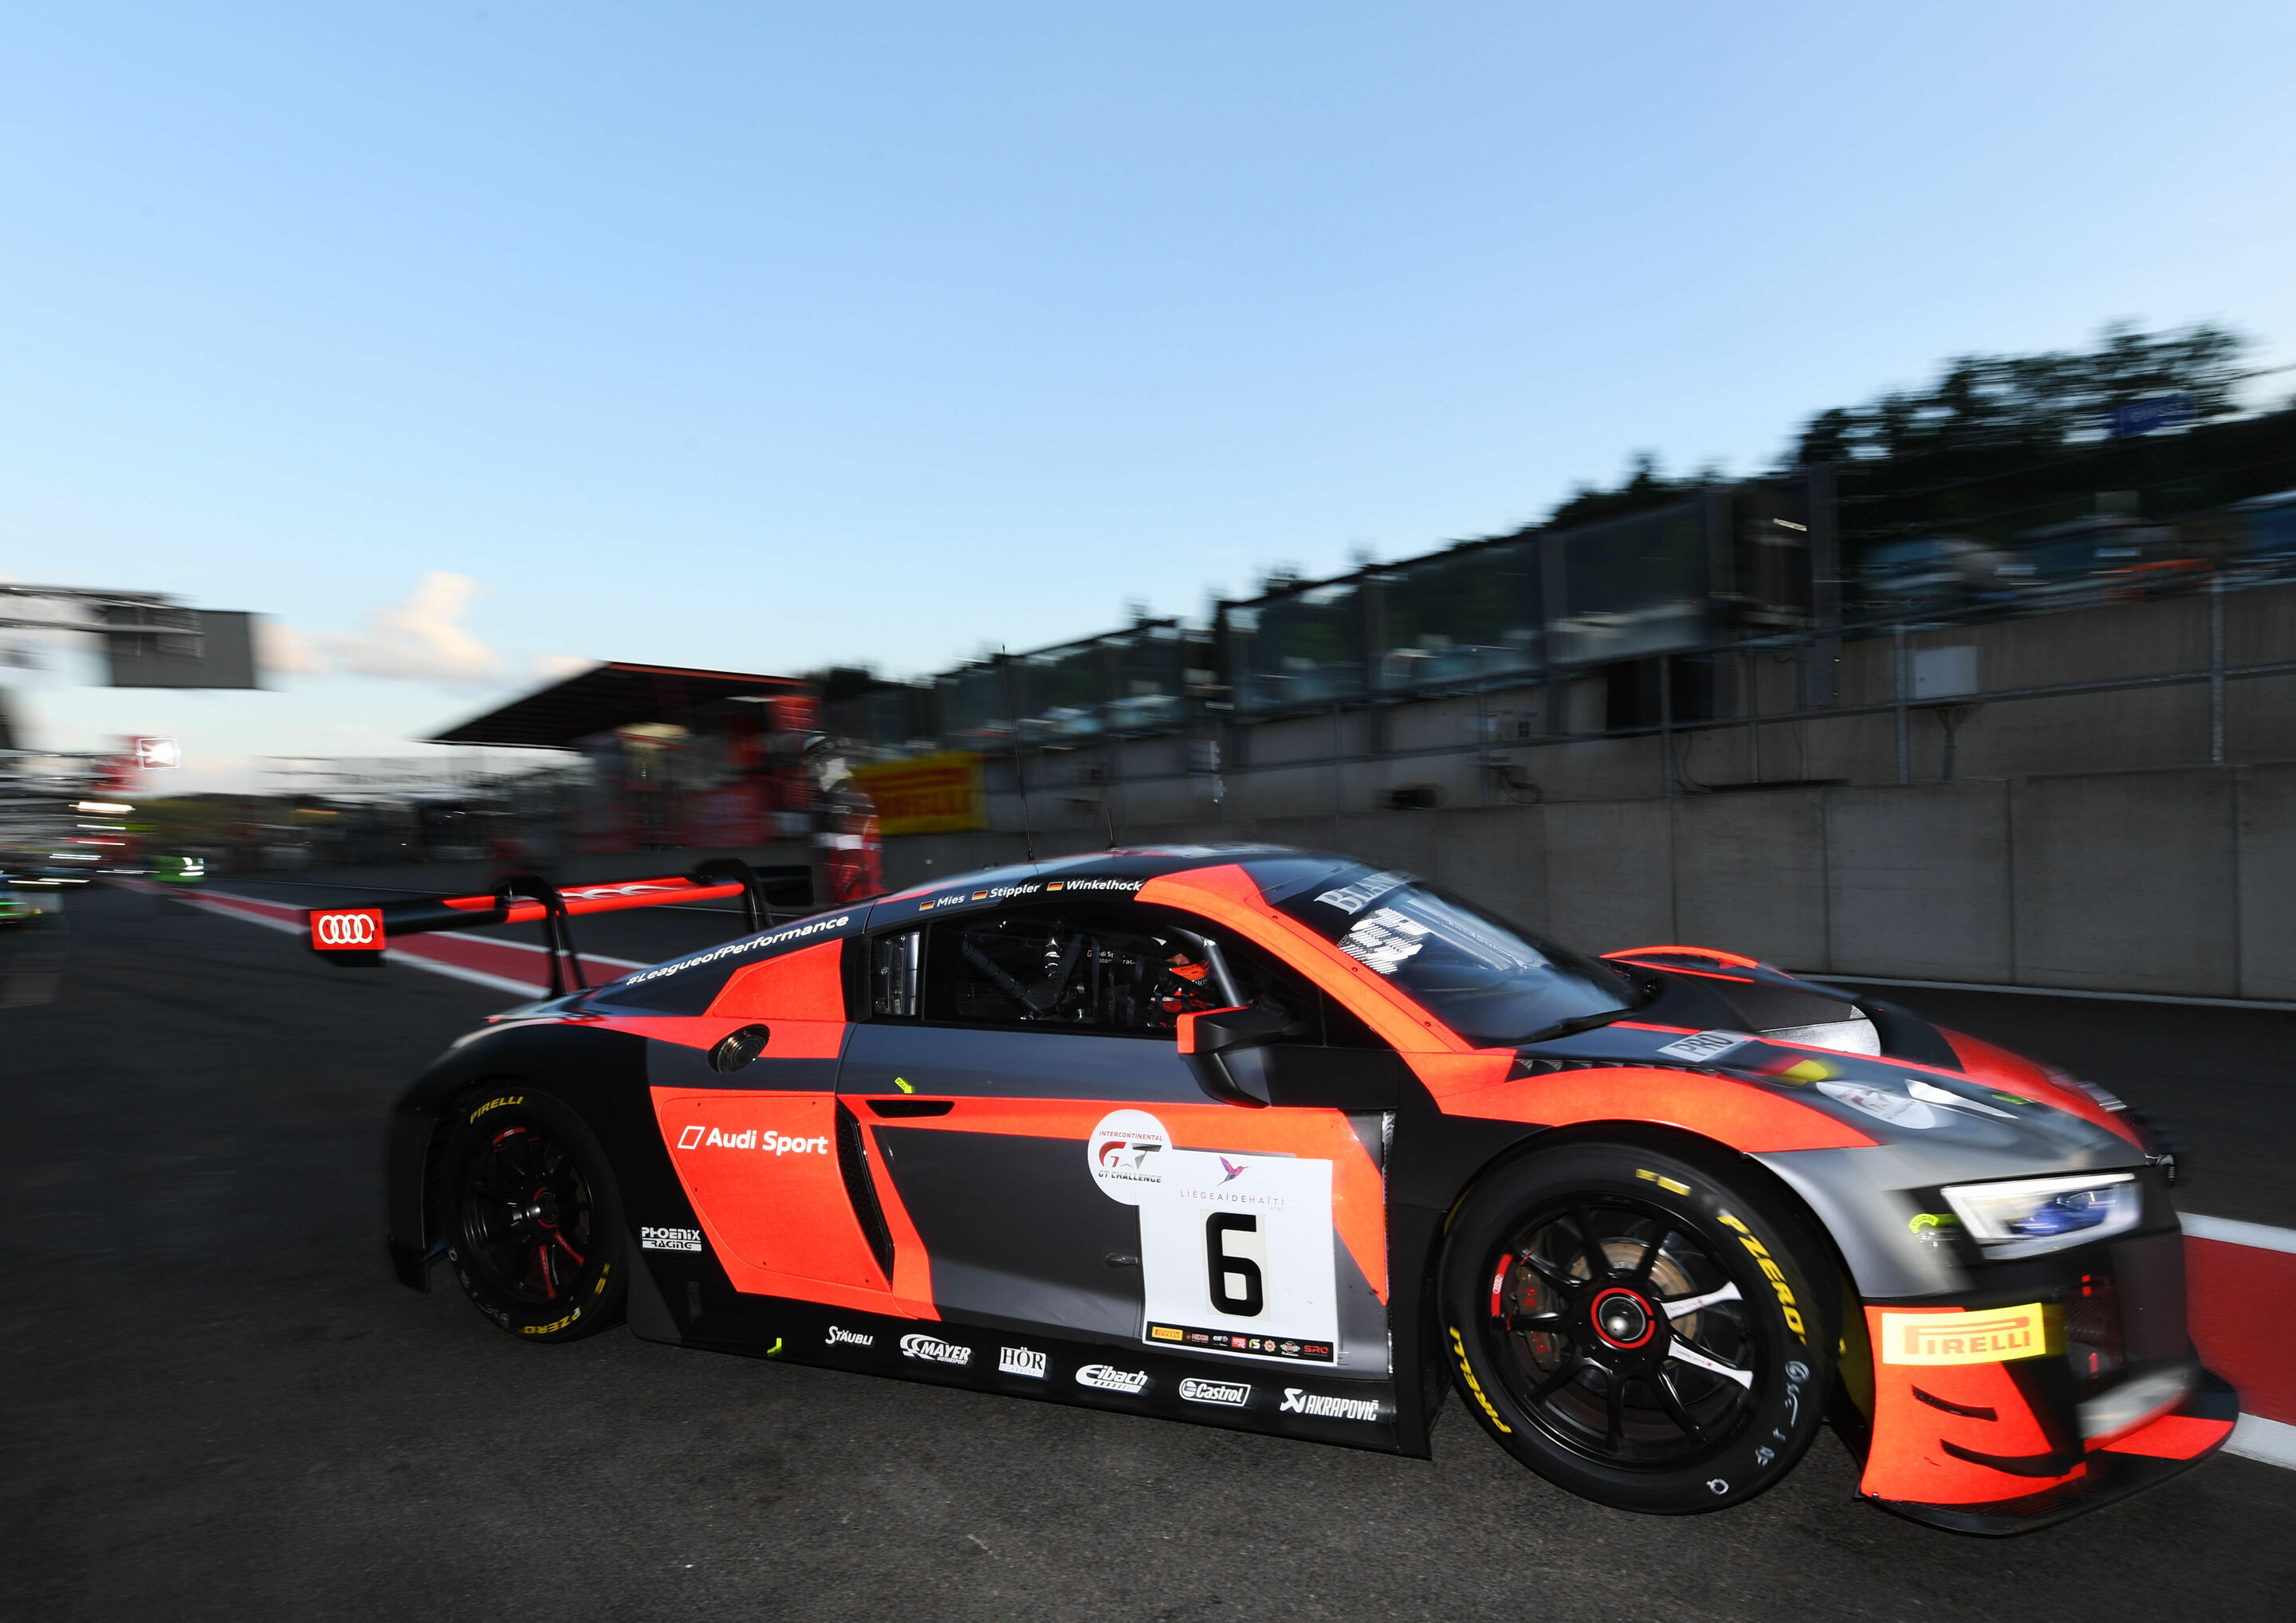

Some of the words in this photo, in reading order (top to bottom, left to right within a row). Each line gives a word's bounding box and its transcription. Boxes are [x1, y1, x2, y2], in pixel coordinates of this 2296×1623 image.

[936, 894, 965, 908] Mies
[989, 882, 1040, 898] Stippler
[1066, 879, 1143, 892] Winkelhock
[626, 916, 849, 986] #LeagueofPerformance
[1671, 1034, 1734, 1056] PRO
[470, 1095, 524, 1125] PIRELLI
[706, 1127, 757, 1149] Audi
[762, 1130, 828, 1156] Sport
[1099, 1130, 1163, 1142] INTERCONTINENTAL
[1111, 1170, 1162, 1183] CHALLENGE
[1206, 1212, 1264, 1317] 6
[1904, 1316, 2031, 1355] PIRELLI
[920, 1341, 972, 1361] MAYER
[937, 1356, 969, 1366] MOTORSPORT
[1002, 1347, 1044, 1370] HÖR
[1303, 1345, 1329, 1354] SRO
[1075, 1364, 1149, 1388] Eibach
[1449, 1325, 1513, 1434] PIRELLI
[1197, 1381, 1244, 1402] Castrol
